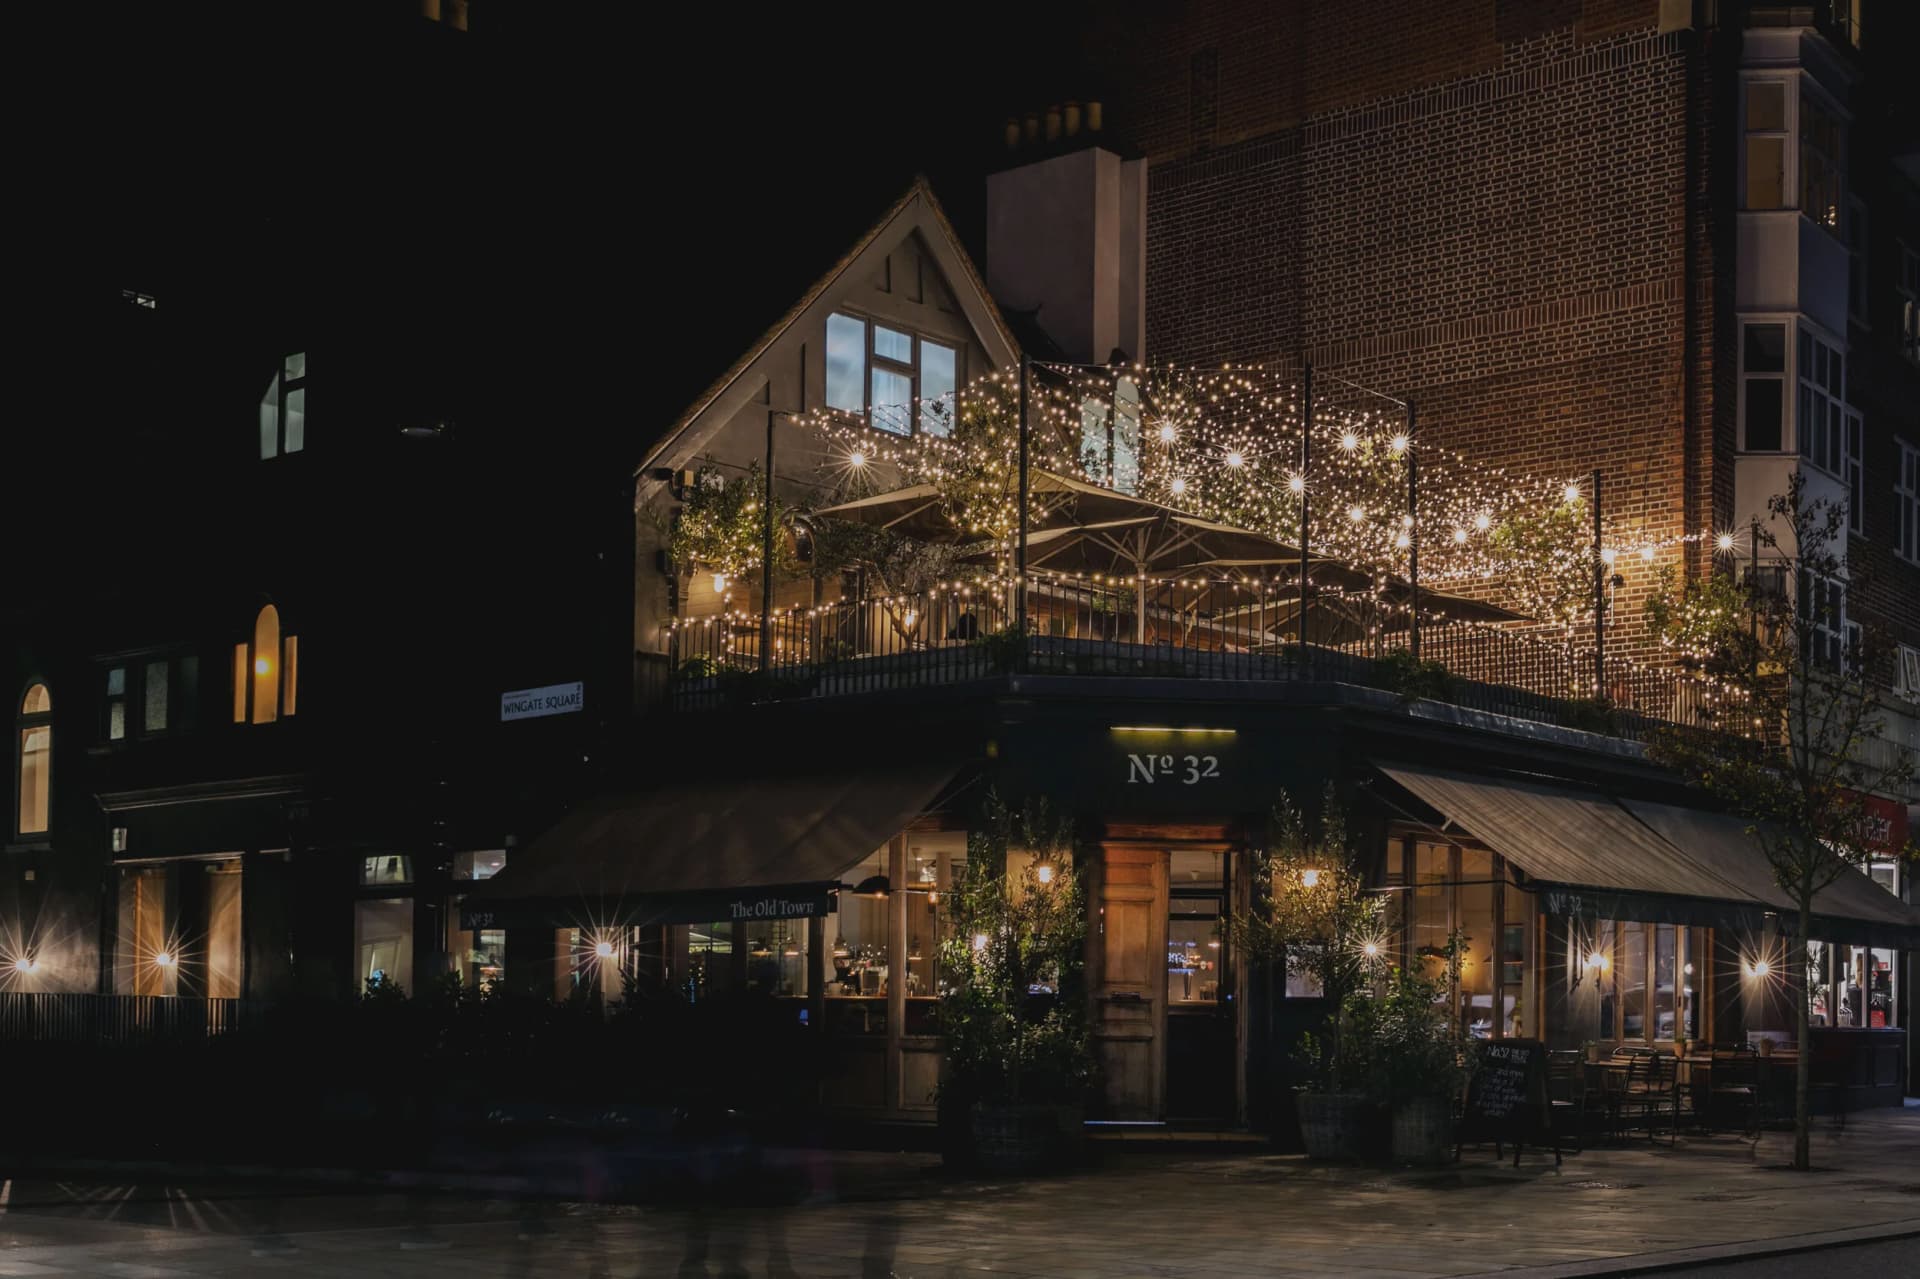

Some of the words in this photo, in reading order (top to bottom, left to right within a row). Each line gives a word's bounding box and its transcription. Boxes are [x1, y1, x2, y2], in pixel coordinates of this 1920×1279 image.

[503, 698, 543, 714] WINGATE
[545, 694, 580, 708] SQUARE
[1183, 755, 1220, 785] 32
[730, 900, 753, 918] The
[755, 899, 778, 917] Old
[780, 900, 815, 915] Town
[1569, 895, 1583, 915] 32
